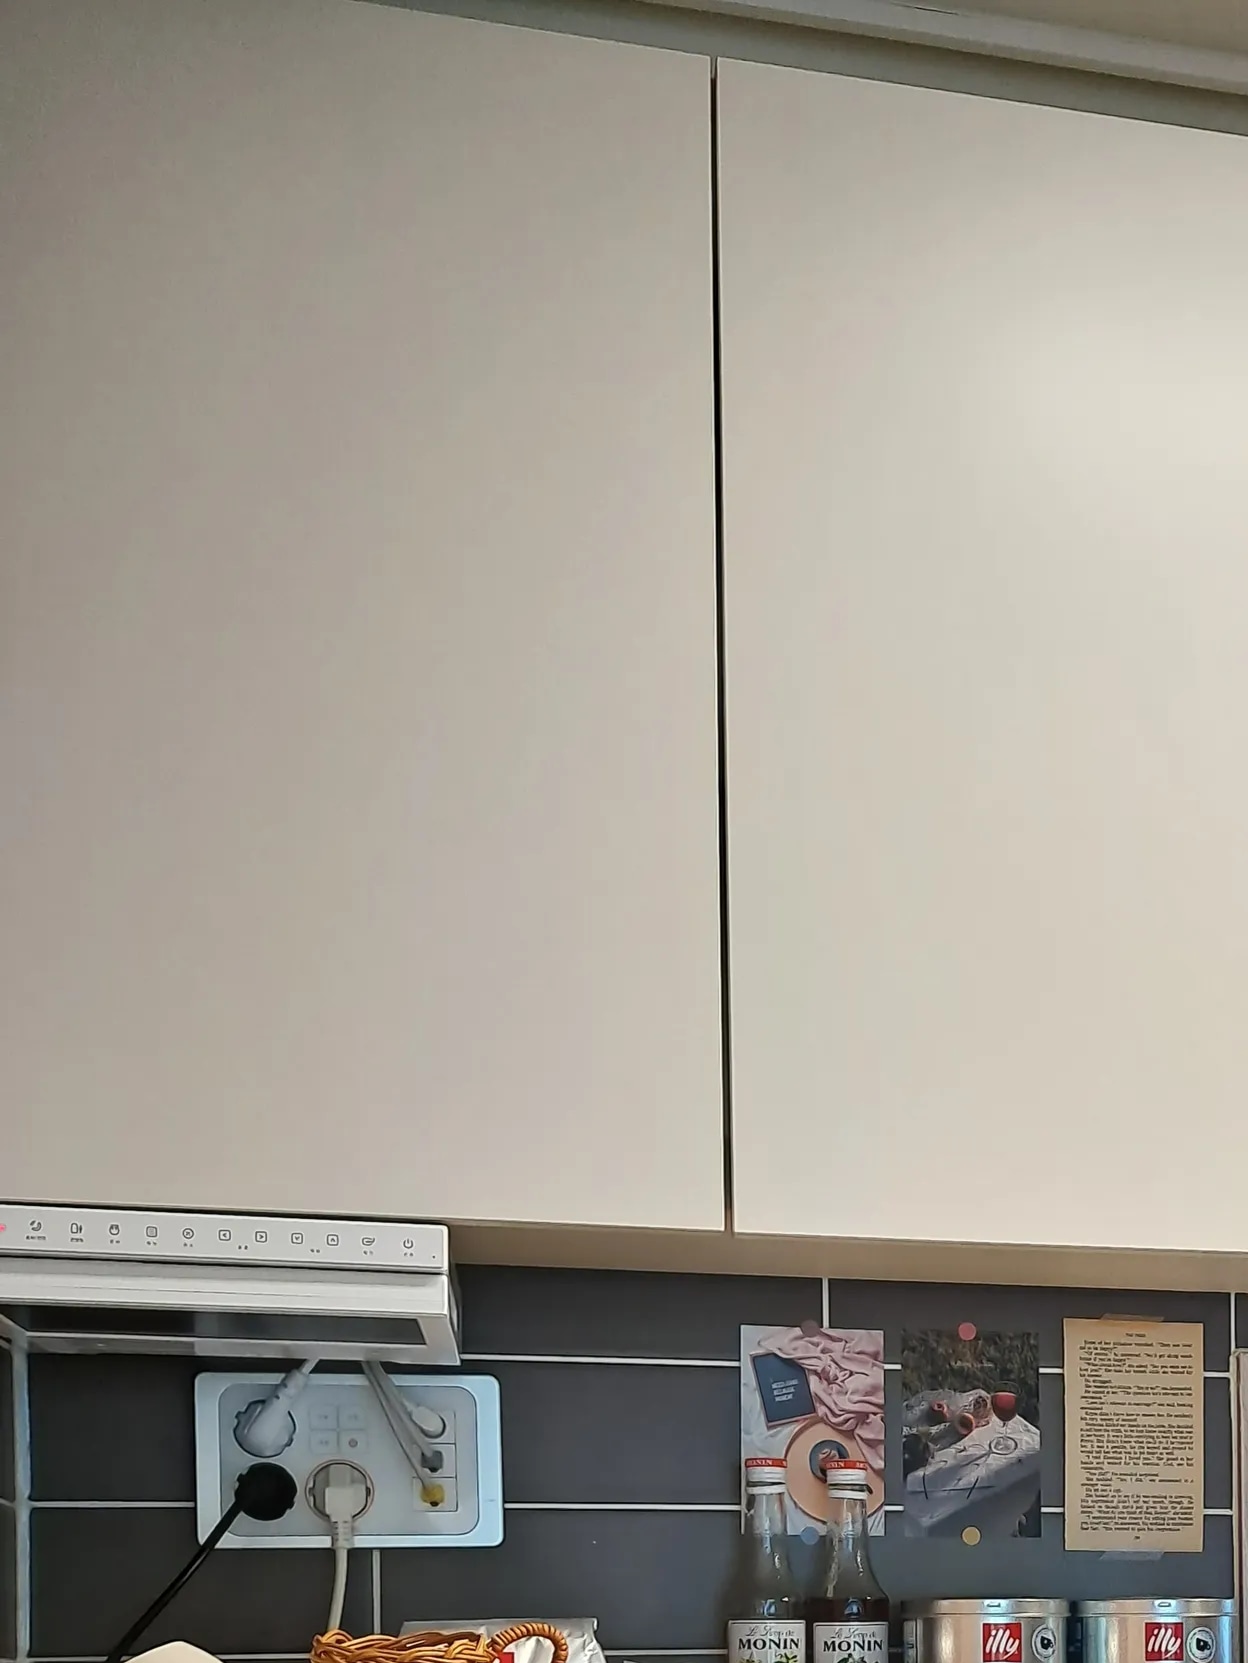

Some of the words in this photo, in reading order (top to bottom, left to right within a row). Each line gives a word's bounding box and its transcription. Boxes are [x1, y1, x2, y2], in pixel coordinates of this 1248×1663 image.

[738, 1638, 800, 1650] MONIN
[823, 1639, 883, 1652] MONIN
[986, 1628, 1020, 1660] illy
[1147, 1627, 1182, 1659] illy
